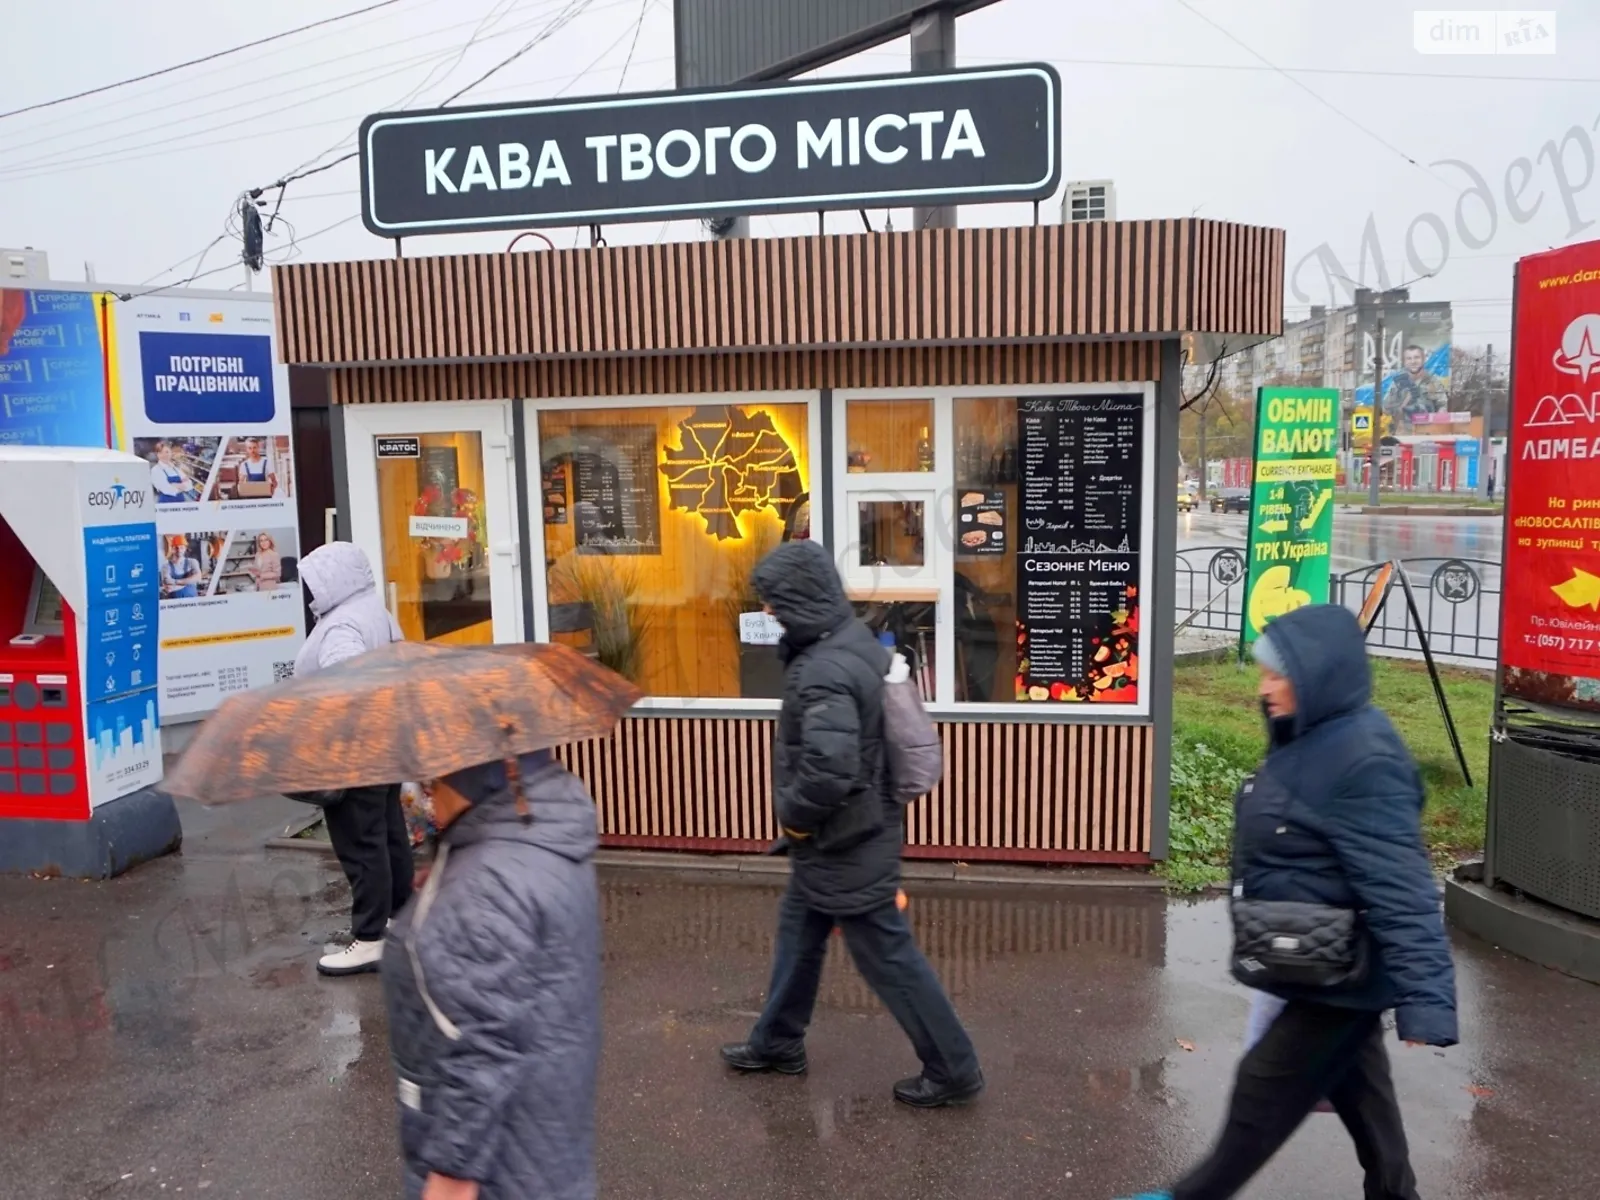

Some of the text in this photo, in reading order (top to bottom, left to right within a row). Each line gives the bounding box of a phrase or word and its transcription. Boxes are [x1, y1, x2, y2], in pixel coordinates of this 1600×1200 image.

[425, 109, 986, 195] КАВА ТВОГО МІСТА
[13, 327, 57, 337] РОБУЙ
[170, 355, 244, 373] ПОТРІБНІ
[155, 374, 261, 394] ПРАЦІВНИКИ
[1021, 399, 1136, 412] Кава Твого Міста
[1267, 397, 1333, 423] ОБМІН
[379, 443, 417, 452] КРАТОС
[1262, 427, 1335, 454] ВАЛЮТ
[1260, 464, 1333, 477] CURRENCY EXCHANGE
[1259, 499, 1292, 516] РІВЕНЬ
[1548, 497, 1566, 508] На
[415, 522, 461, 531] ВІДЧИНЕНО
[1255, 539, 1328, 562] ТРК Україна
[1518, 537, 1532, 546] на
[1536, 537, 1584, 549] зупинці
[1531, 615, 1548, 627] Пр.
[1537, 633, 1565, 650] (057)
[1568, 638, 1594, 651] 717
[124, 760, 149, 775] 334 33 29
